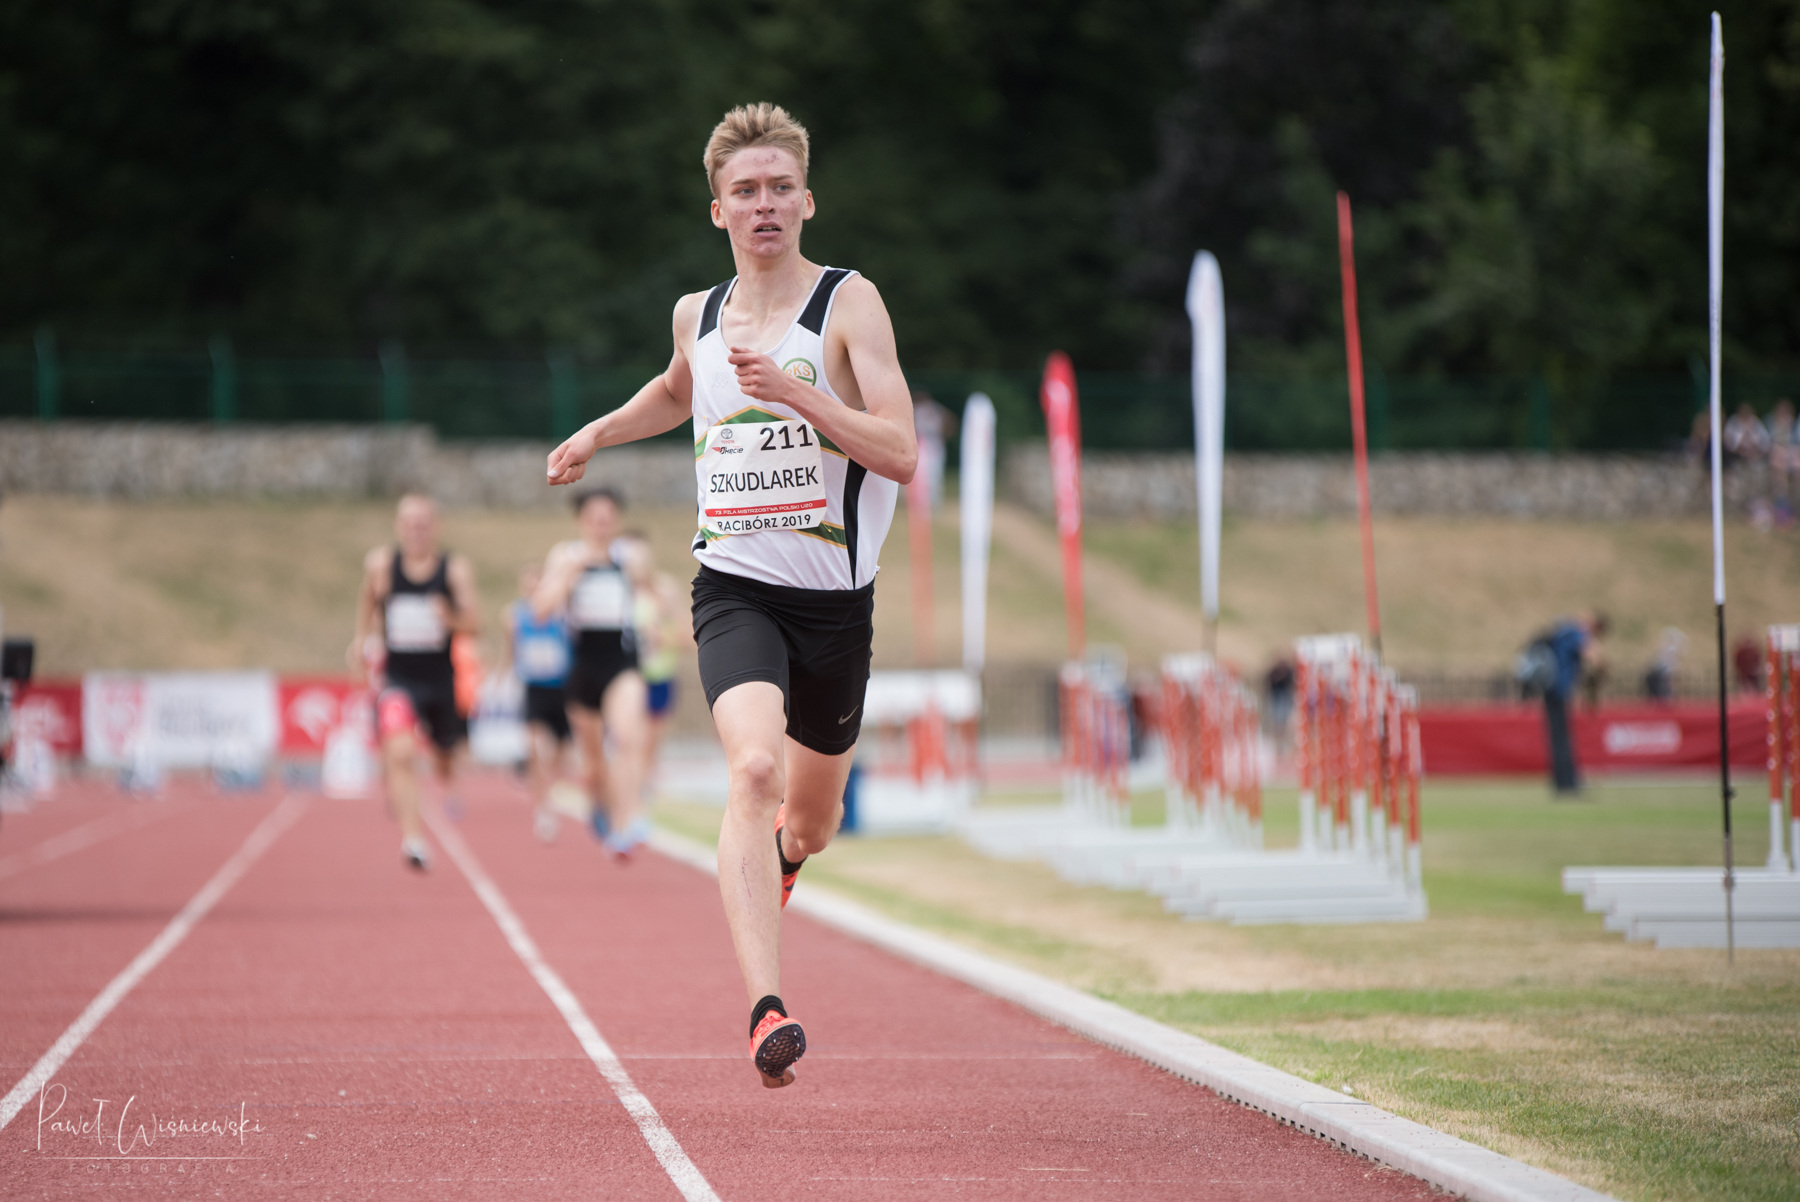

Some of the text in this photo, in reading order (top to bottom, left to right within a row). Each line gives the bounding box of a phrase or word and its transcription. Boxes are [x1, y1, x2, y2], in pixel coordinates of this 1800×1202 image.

[760, 423, 813, 451] 211
[710, 465, 818, 493] SZKUDLAREK
[737, 506, 779, 514] MISTRZOSTWA
[717, 514, 811, 531] RACIBÓRZ 2019
